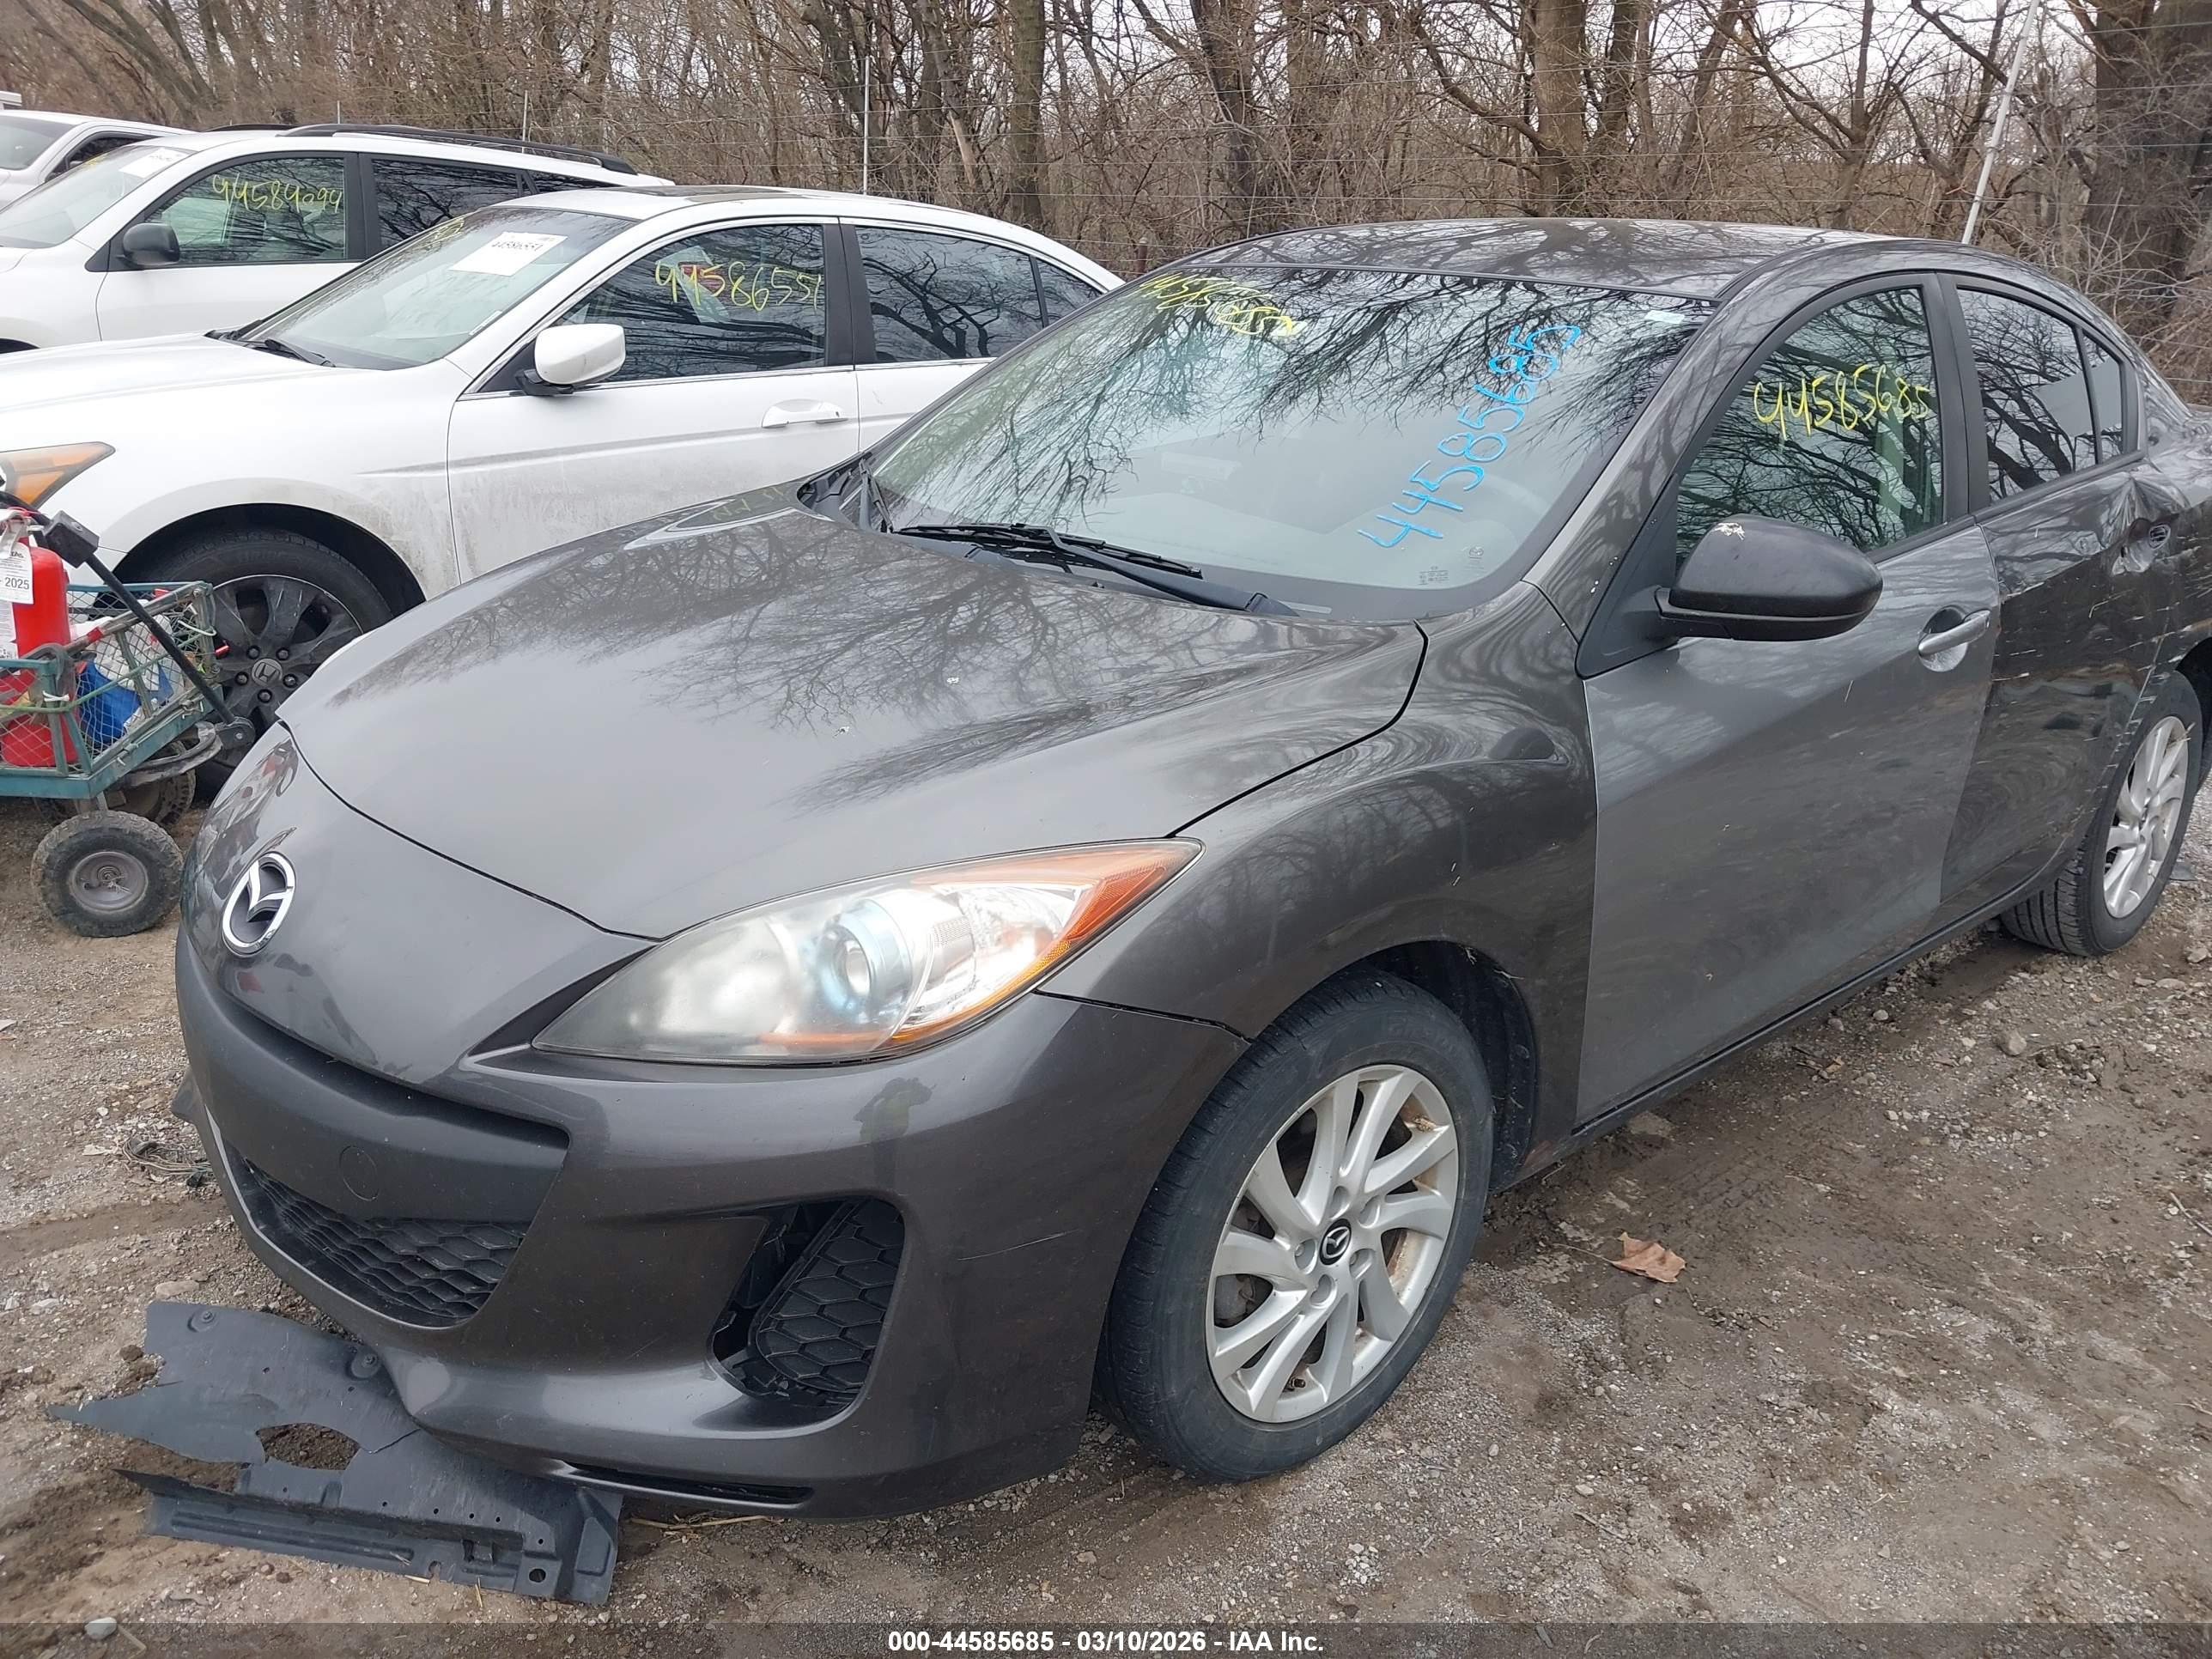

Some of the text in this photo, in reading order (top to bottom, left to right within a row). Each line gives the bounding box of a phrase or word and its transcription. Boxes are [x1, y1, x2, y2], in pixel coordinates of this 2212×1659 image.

[1358, 325, 1581, 547] 44585685
[1754, 364, 1930, 441] 44585685
[4, 576, 30, 590] 2025
